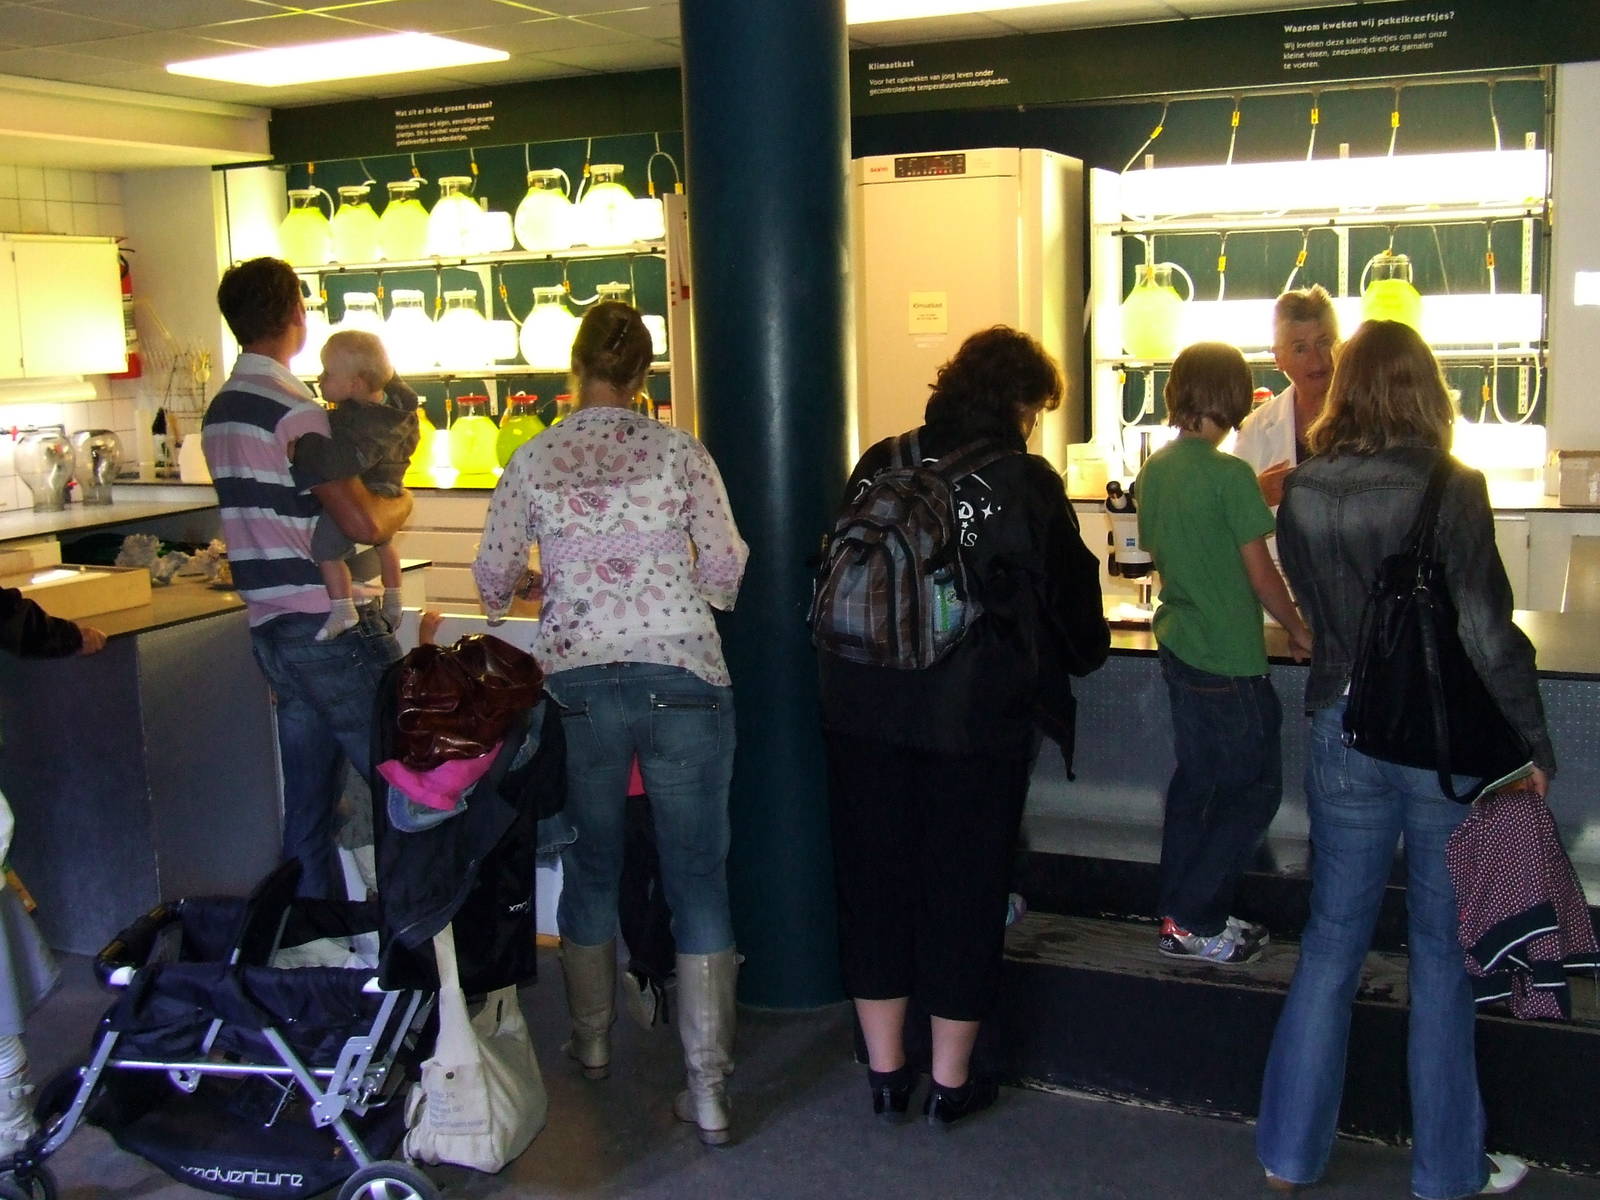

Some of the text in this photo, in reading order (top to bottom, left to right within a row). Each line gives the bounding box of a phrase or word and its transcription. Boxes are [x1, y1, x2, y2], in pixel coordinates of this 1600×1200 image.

[1284, 11, 1455, 33] Waarom kweken wij pekelkreeftjes?
[1283, 30, 1448, 51] Wij kweken deze kleine diertjes om aan onze
[1283, 51, 1305, 60] kleine
[1306, 49, 1330, 58] vissen,
[1332, 45, 1377, 57] zeepaardjes
[1389, 43, 1400, 52] de
[1401, 41, 1434, 52] garnalen
[868, 60, 915, 71] Klimaatkast
[1283, 60, 1320, 70] te voeren.
[885, 77, 896, 85] het
[956, 71, 974, 79] leven
[974, 69, 995, 77] onder
